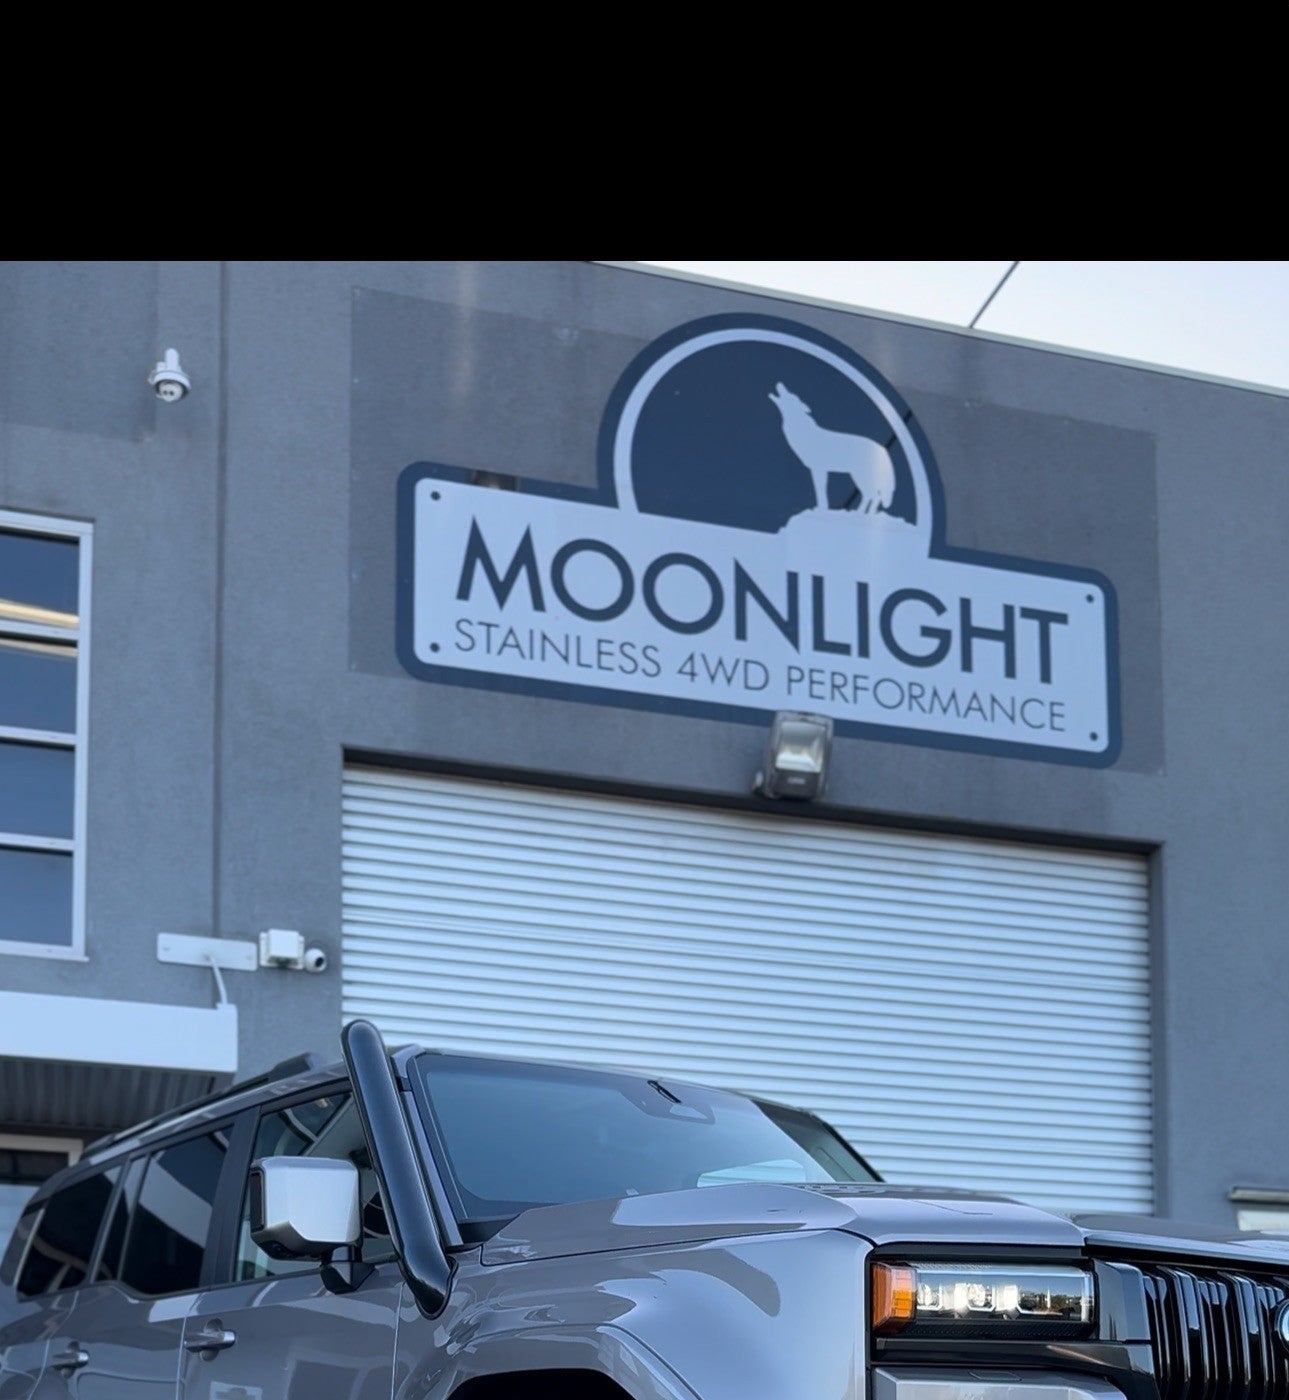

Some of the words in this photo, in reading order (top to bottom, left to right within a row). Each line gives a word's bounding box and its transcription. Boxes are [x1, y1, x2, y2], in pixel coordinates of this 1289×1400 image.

[455, 515, 1069, 685] MOONLIGHT
[454, 618, 662, 678] STAINLESS
[677, 652, 770, 692] 4WD
[787, 668, 1067, 732] PERFORMANCE
